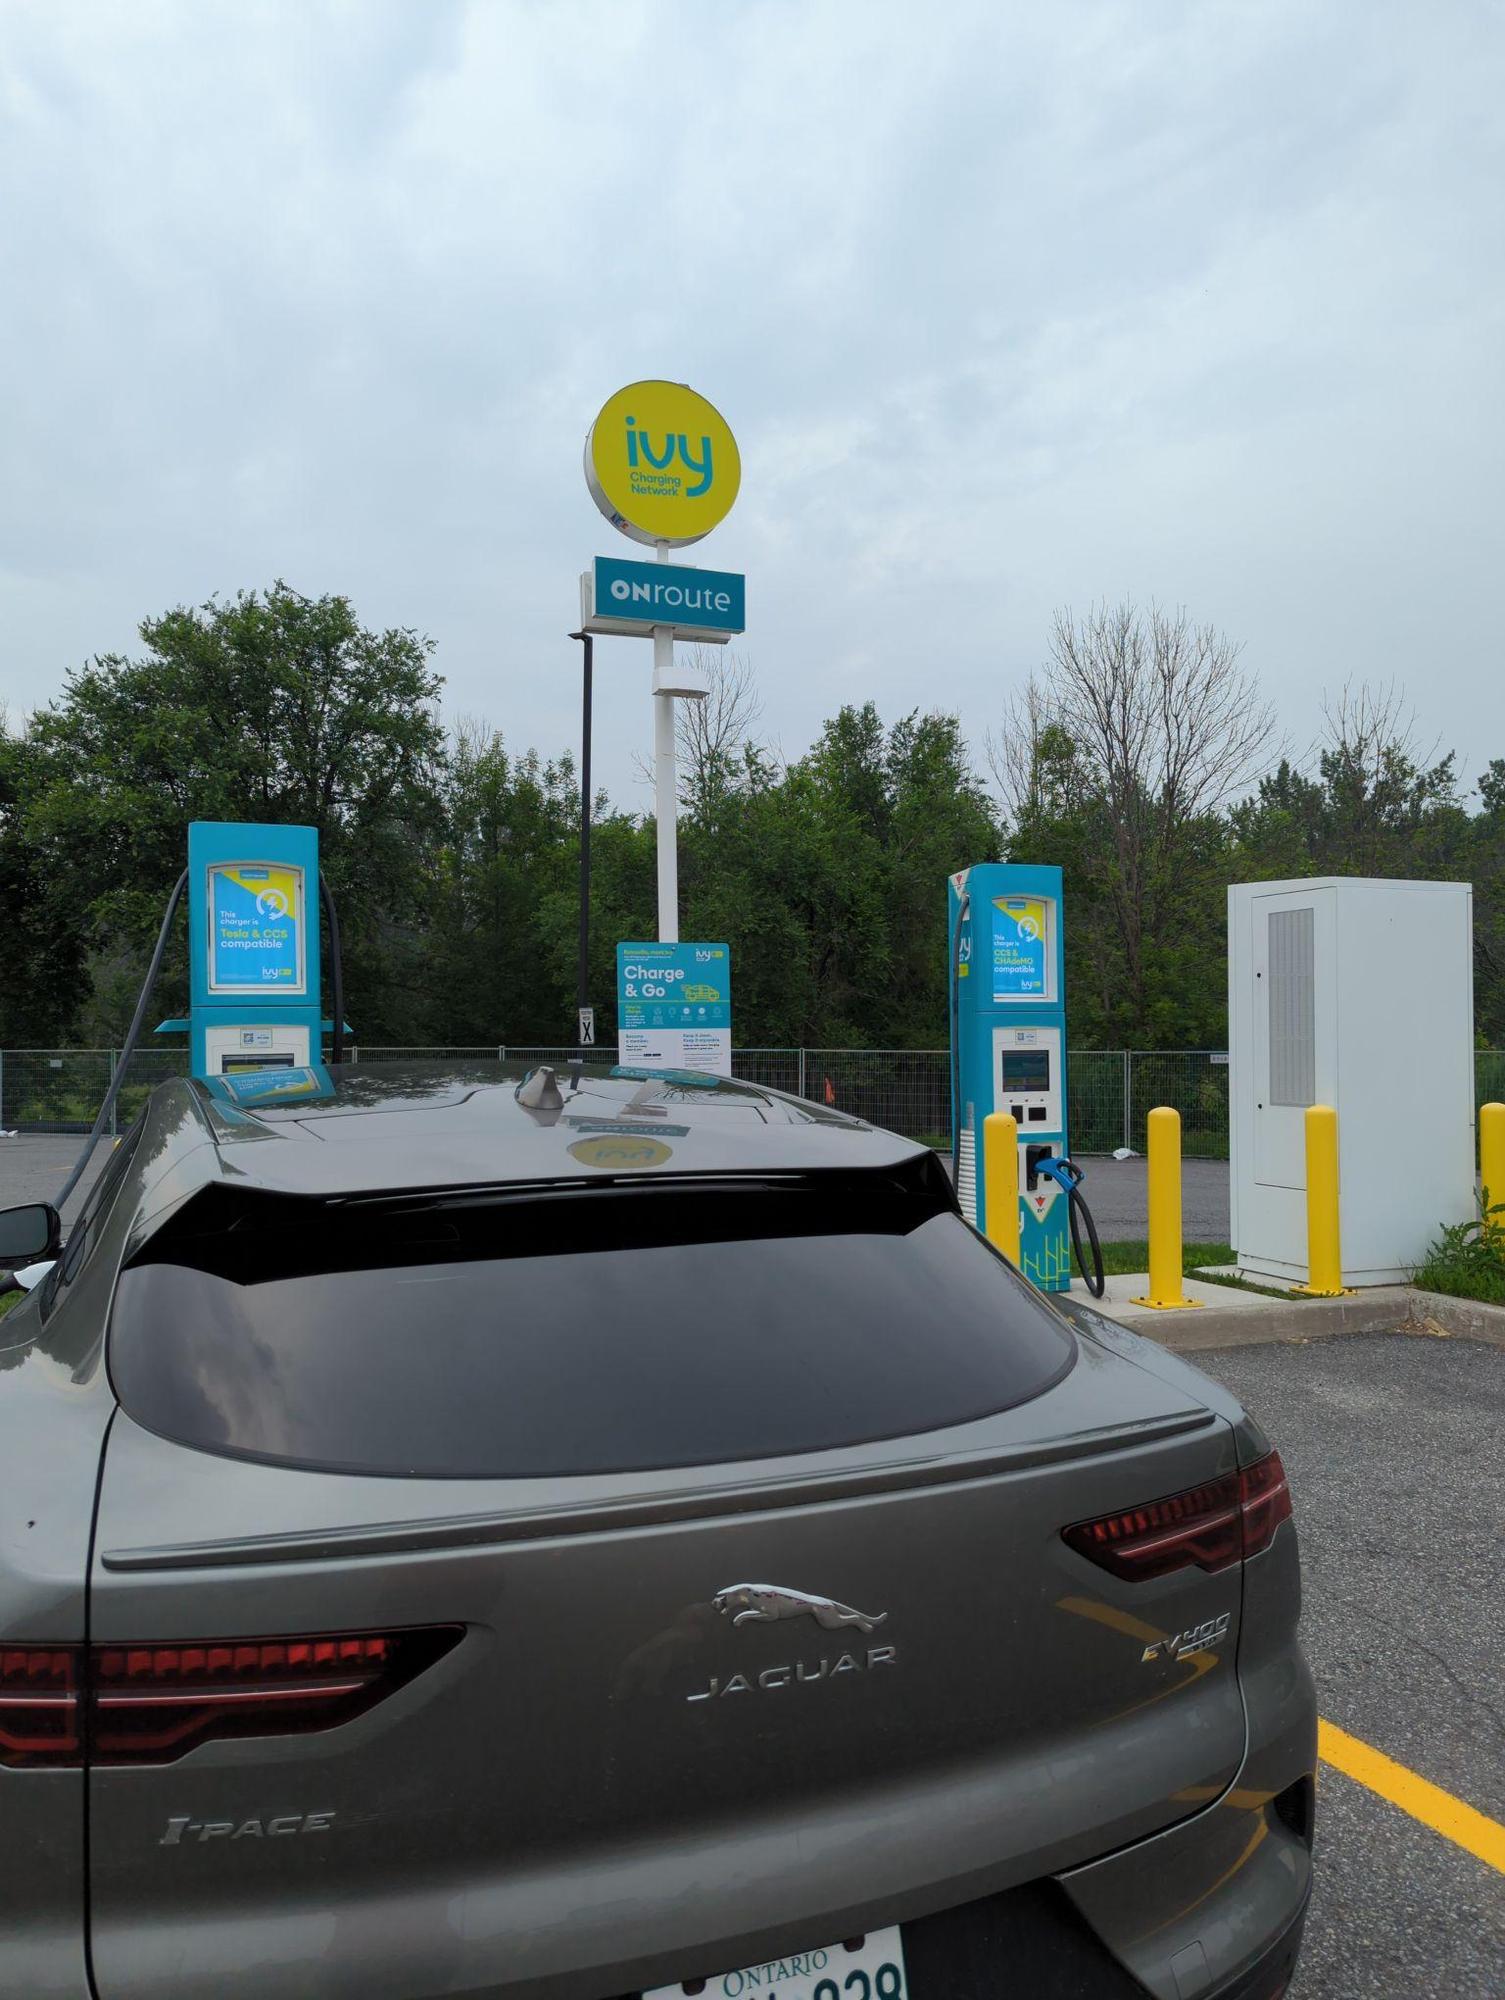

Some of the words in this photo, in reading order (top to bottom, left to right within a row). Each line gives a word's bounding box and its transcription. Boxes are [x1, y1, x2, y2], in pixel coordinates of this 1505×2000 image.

[625, 415, 714, 497] ivy
[630, 472, 682, 487] Charging
[631, 483, 679, 497] Network
[610, 579, 731, 612] ONroute
[220, 910, 236, 918] This
[220, 918, 250, 926] charger
[221, 928, 249, 939] Tesla
[251, 929, 260, 939] &
[263, 929, 288, 939] CCS
[221, 939, 283, 950] compatible
[695, 948, 711, 962] ivy
[262, 966, 279, 979] ivy
[624, 965, 685, 983] Charge
[994, 965, 1035, 975] compatible
[625, 983, 638, 997] &
[642, 983, 665, 997] Go
[1141, 1612, 1231, 1663] EV400
[686, 1645, 897, 1702] JAGUAR
[723, 1949, 828, 1998] ONTARIO
